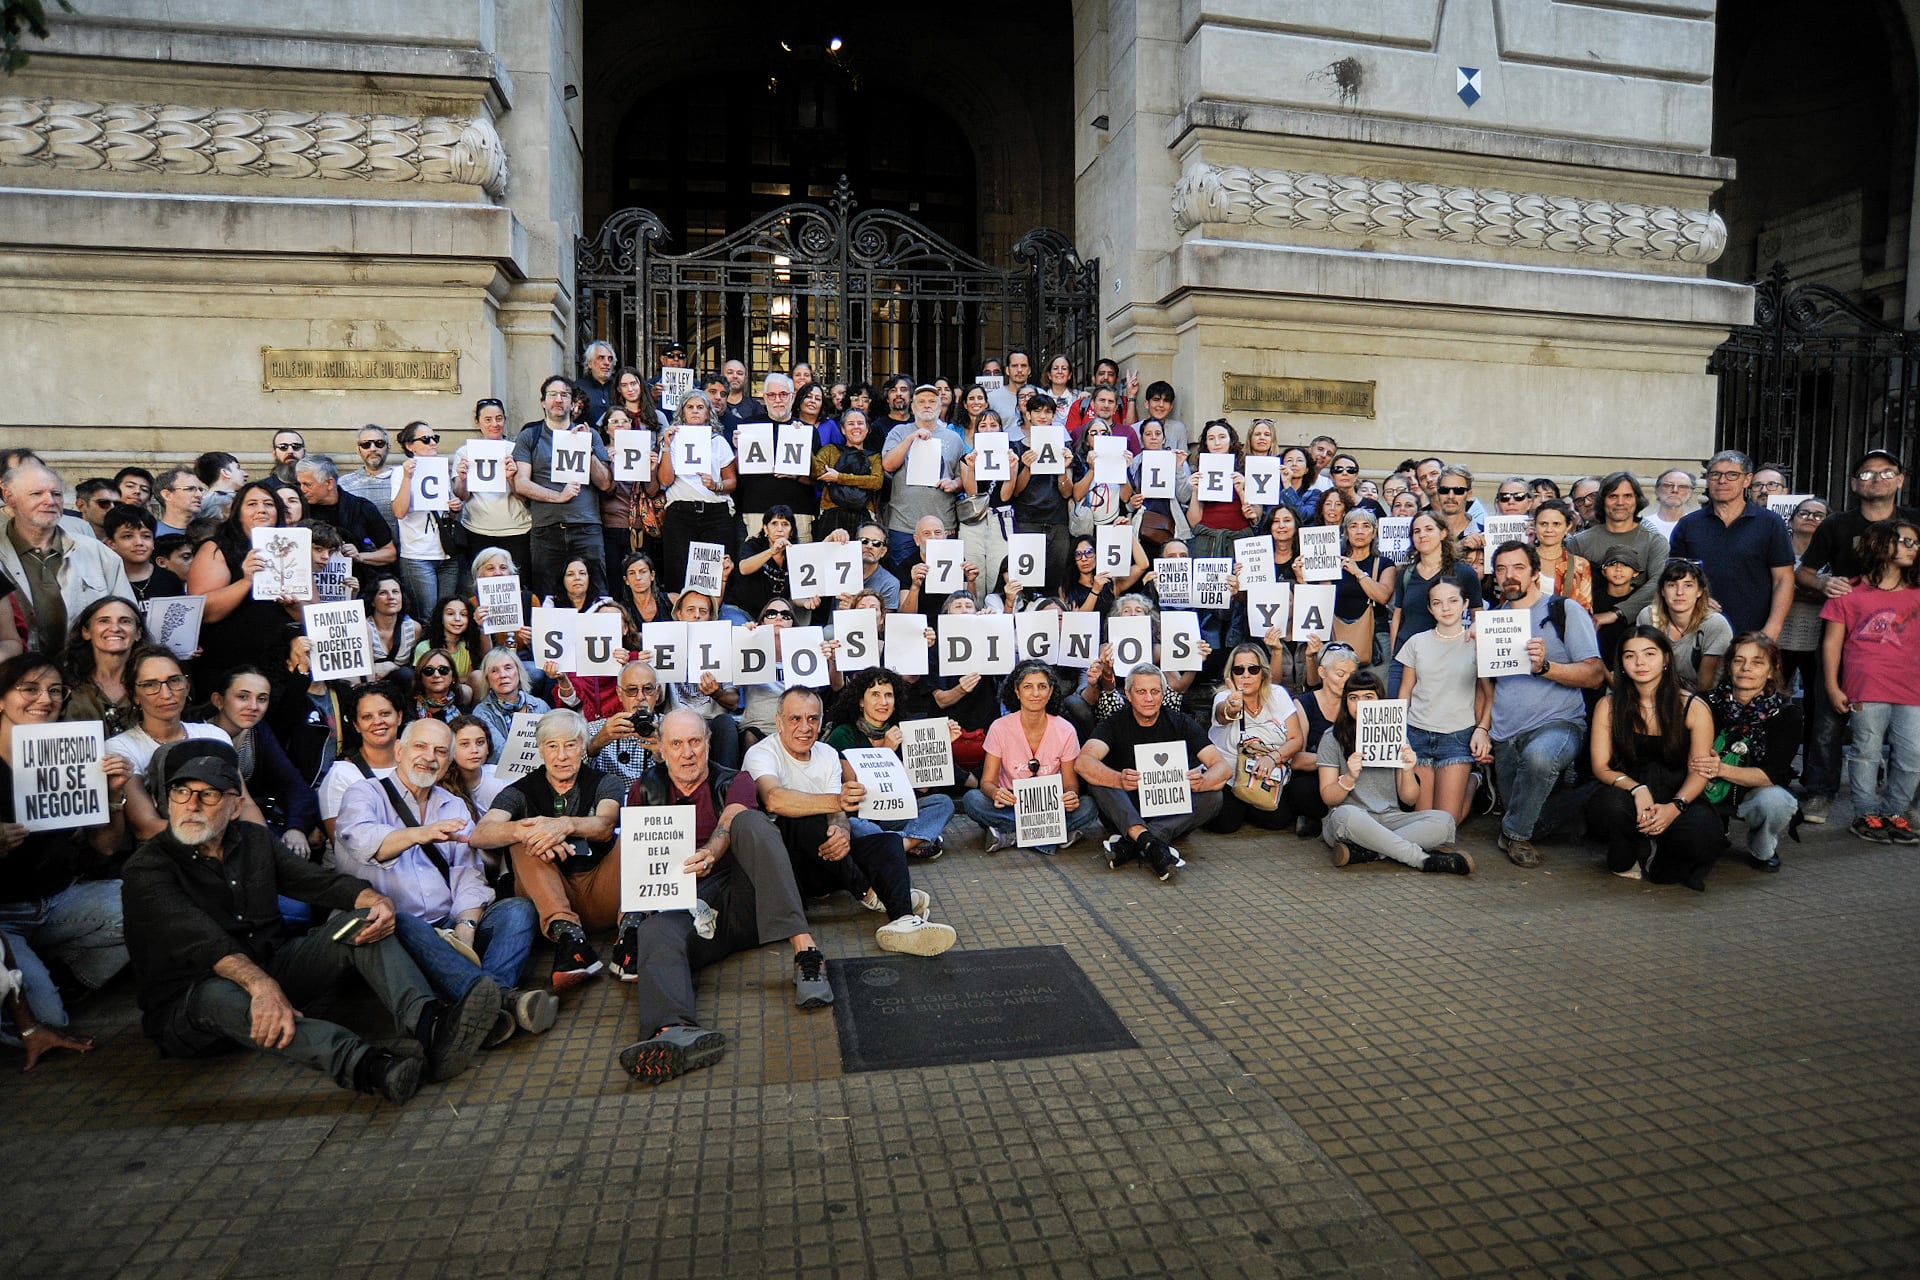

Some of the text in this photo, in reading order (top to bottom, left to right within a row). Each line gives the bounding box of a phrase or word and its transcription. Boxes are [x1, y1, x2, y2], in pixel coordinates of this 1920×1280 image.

[272, 360, 450, 379] COLEGIO NACIONAL DE BUENOS AIRES
[666, 371, 690, 385] SIN LEY
[669, 384, 677, 395] NO
[1231, 384, 1263, 401] COLEGIO
[1382, 523, 1410, 540] EDUCACIÓ
[1489, 522, 1526, 533] SIN SALARIOS
[1303, 532, 1336, 545] APOYAMOS
[1393, 539, 1401, 550] ES
[693, 547, 721, 562] FAMILIAS
[1313, 545, 1327, 556] A LA
[700, 562, 710, 574] DEL
[1158, 562, 1188, 573] FAMILIAS
[1197, 563, 1228, 573] FAMILIAS
[1304, 555, 1338, 570] DOCENCIA
[689, 575, 718, 589] NACIONAL
[1159, 573, 1188, 583] CNBA
[1206, 574, 1218, 582] CON
[1246, 575, 1267, 583] 27.795
[325, 586, 333, 595] LA
[335, 586, 346, 595] LEY
[491, 583, 496, 593] LA
[1159, 583, 1188, 592] POR LA LEY
[1197, 582, 1228, 592] DOCENTES
[490, 593, 510, 604] DE LA LEY
[1201, 592, 1223, 605] UBA
[313, 609, 359, 627] FAMILIAS
[329, 625, 348, 638] CON
[1484, 626, 1522, 634] APLICACIÓN
[317, 636, 362, 653] DOCENTES
[1497, 648, 1511, 656] LEY
[319, 650, 364, 672] CNBA
[1490, 660, 1519, 669] 27.795
[1362, 706, 1403, 725] SALARIOS
[914, 727, 936, 743] QUE NO
[1362, 725, 1402, 743] DIGNOS
[23, 735, 97, 768] LA UNIVERSIDAD
[907, 741, 947, 758] DESAPAREZCA
[1362, 744, 1402, 761] ES LEY
[520, 752, 536, 761] LEY
[908, 754, 948, 769] LA UNIVERSIDAD
[860, 761, 895, 769] APLICACIÓN
[36, 764, 87, 793] NO SE
[915, 767, 943, 783] PÚBLICA
[1142, 767, 1184, 785] EDUCACIÓN
[879, 782, 894, 793] LEY
[1019, 784, 1059, 815] FAMILIAS
[1144, 786, 1185, 806] PÚBLICA
[25, 788, 100, 821] NEGOCIA
[872, 798, 904, 811] 27.795
[644, 816, 673, 826] POR LA
[1046, 812, 1054, 825] POR
[1054, 812, 1060, 824] LA
[633, 829, 684, 842] APLICACIÓN
[1021, 826, 1045, 840] UNIVERSIDAD
[648, 846, 670, 856] DE LA
[649, 862, 668, 876] LEY
[639, 883, 679, 897] 27.795
[872, 984, 1061, 1007] COLEGIO NACIONAL
[882, 994, 1057, 1015] DE BUENOS AIRES
